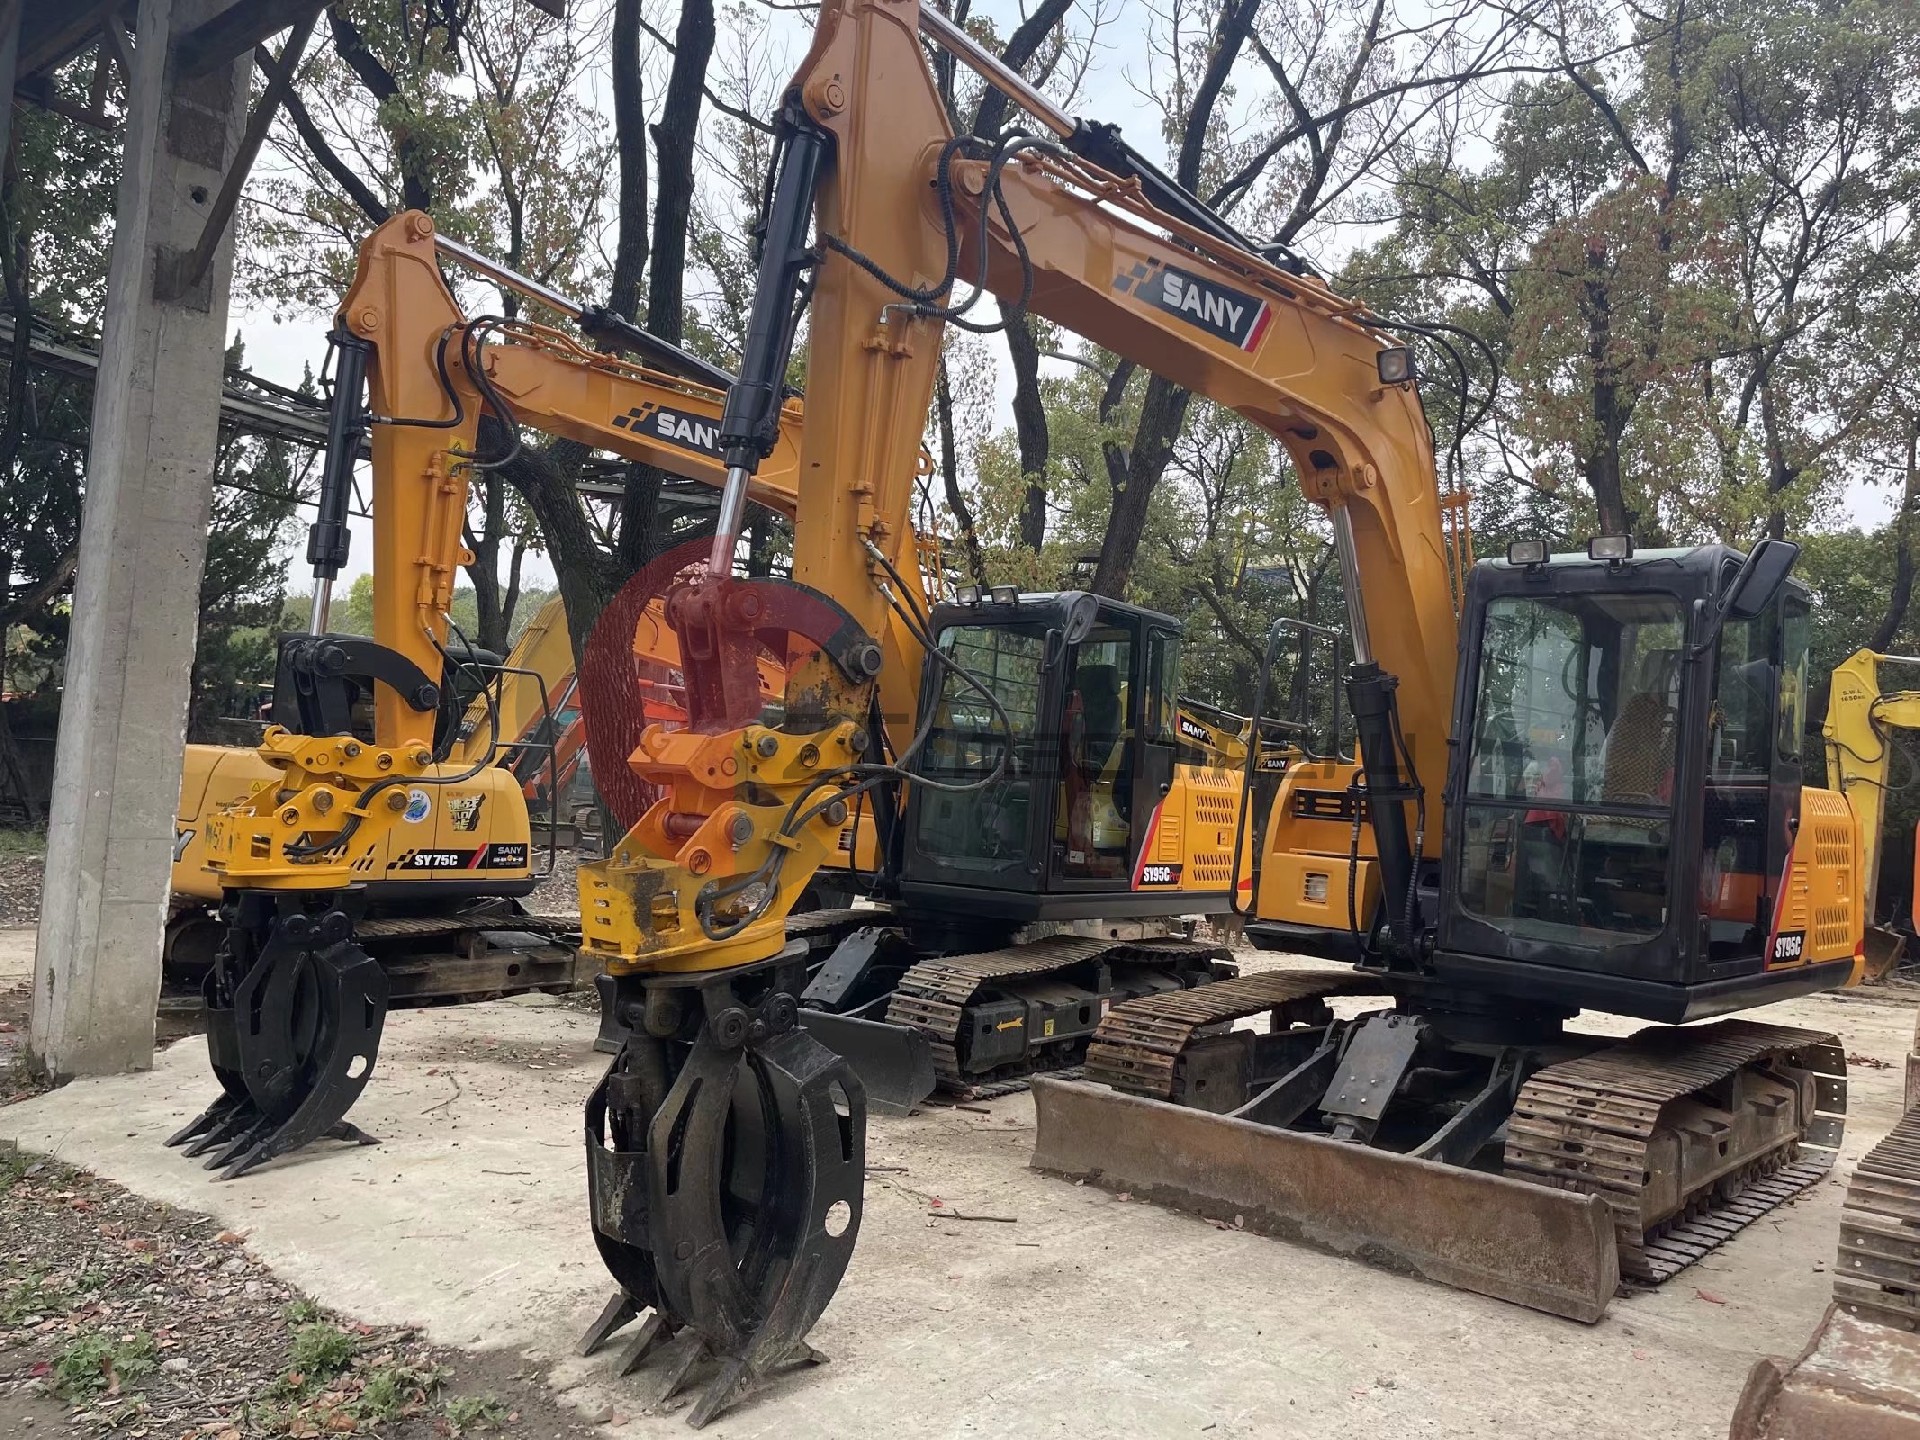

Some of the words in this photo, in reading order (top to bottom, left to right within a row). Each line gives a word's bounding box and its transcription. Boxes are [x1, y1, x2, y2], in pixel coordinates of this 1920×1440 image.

[1162, 272, 1244, 333] SANY
[1181, 721, 1206, 738] SANY
[1267, 760, 1286, 769] SANY
[498, 846, 522, 854] SANY
[1143, 866, 1171, 882] SY95C
[1775, 936, 1802, 958] SY95C
